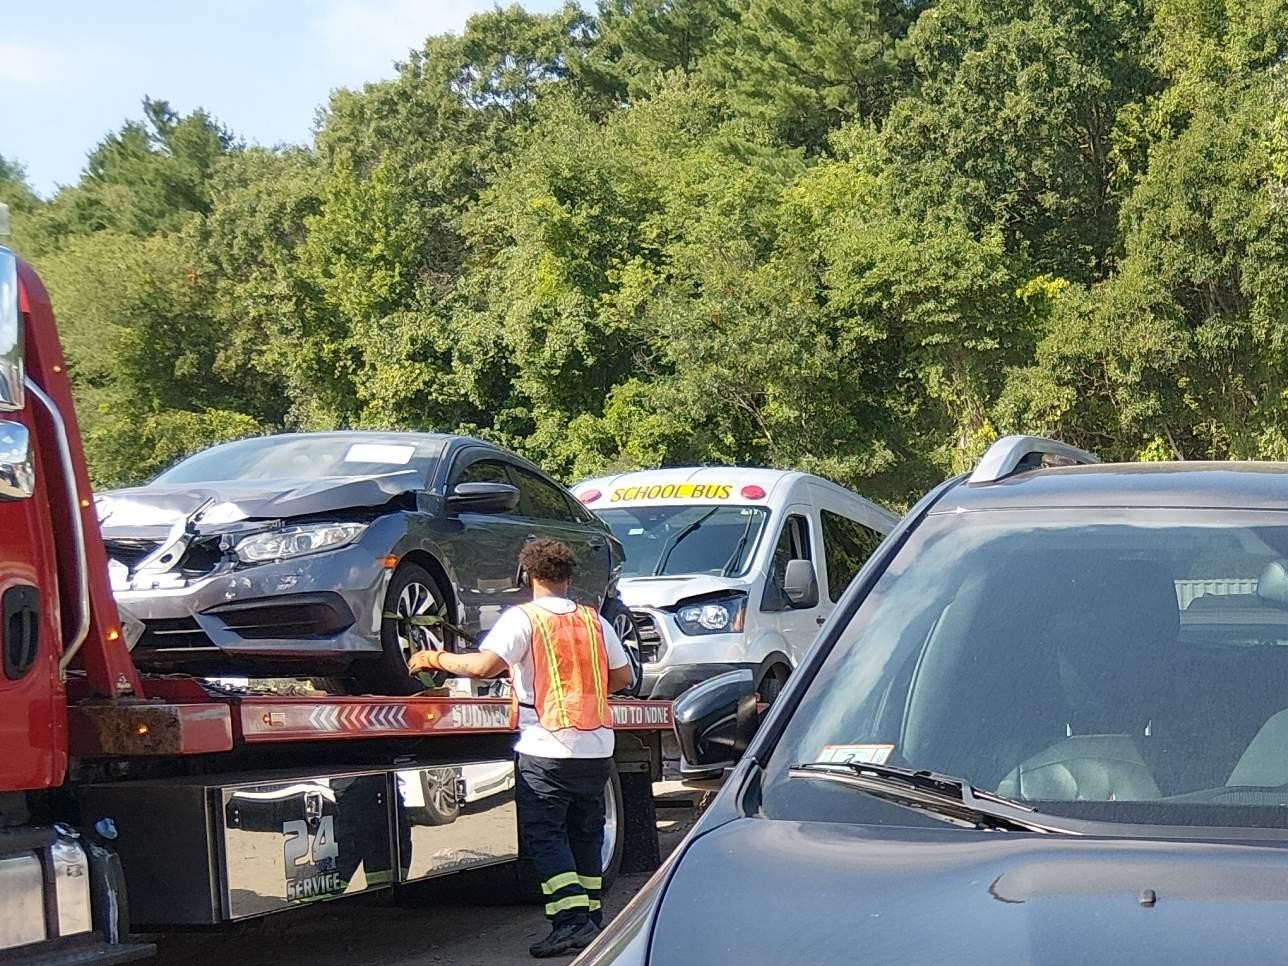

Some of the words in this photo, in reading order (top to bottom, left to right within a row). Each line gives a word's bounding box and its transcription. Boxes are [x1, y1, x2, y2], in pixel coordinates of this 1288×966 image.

[610, 484, 684, 502] SCHOOL
[690, 484, 733, 500] BUS
[630, 706, 643, 724] TO
[644, 706, 669, 724] NONE
[283, 815, 339, 881] 24
[287, 872, 341, 901] SERVICE
